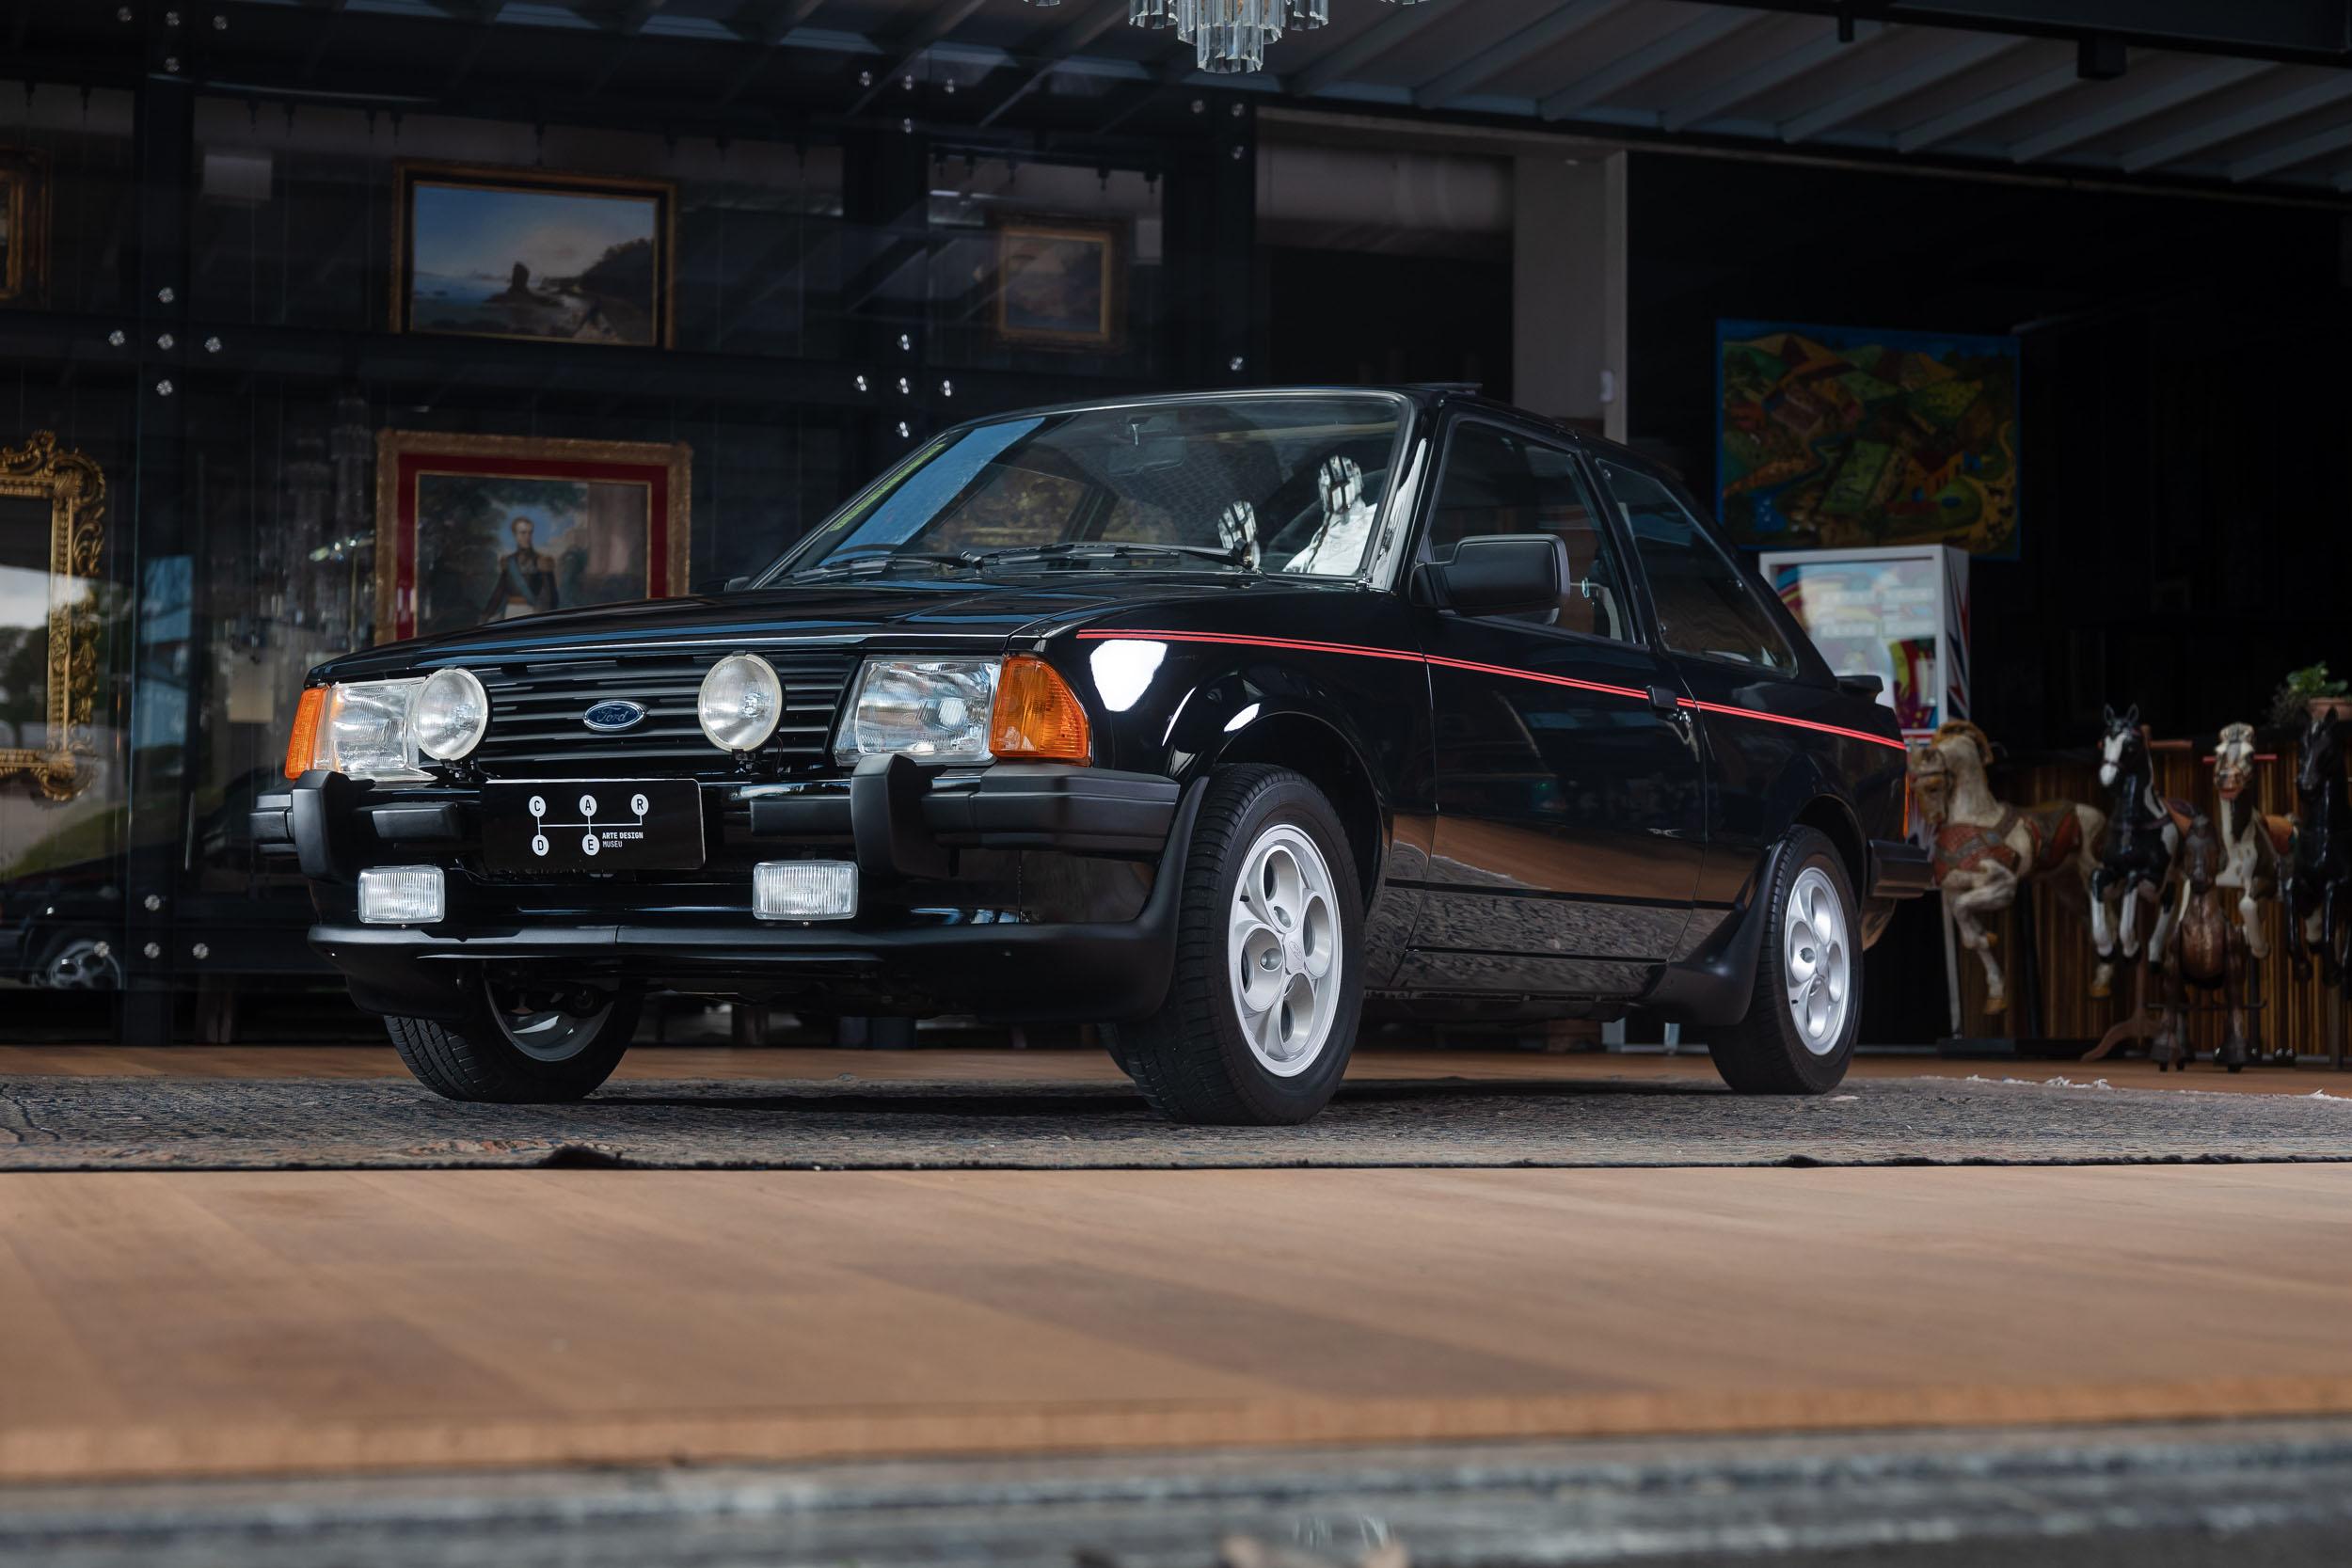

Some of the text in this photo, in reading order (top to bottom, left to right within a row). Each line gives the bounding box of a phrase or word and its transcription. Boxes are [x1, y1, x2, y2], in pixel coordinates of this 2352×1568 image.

[597, 706, 629, 722] Ford
[602, 832, 644, 840] ARTE DESIGN
[602, 840, 623, 848] MUSEU
